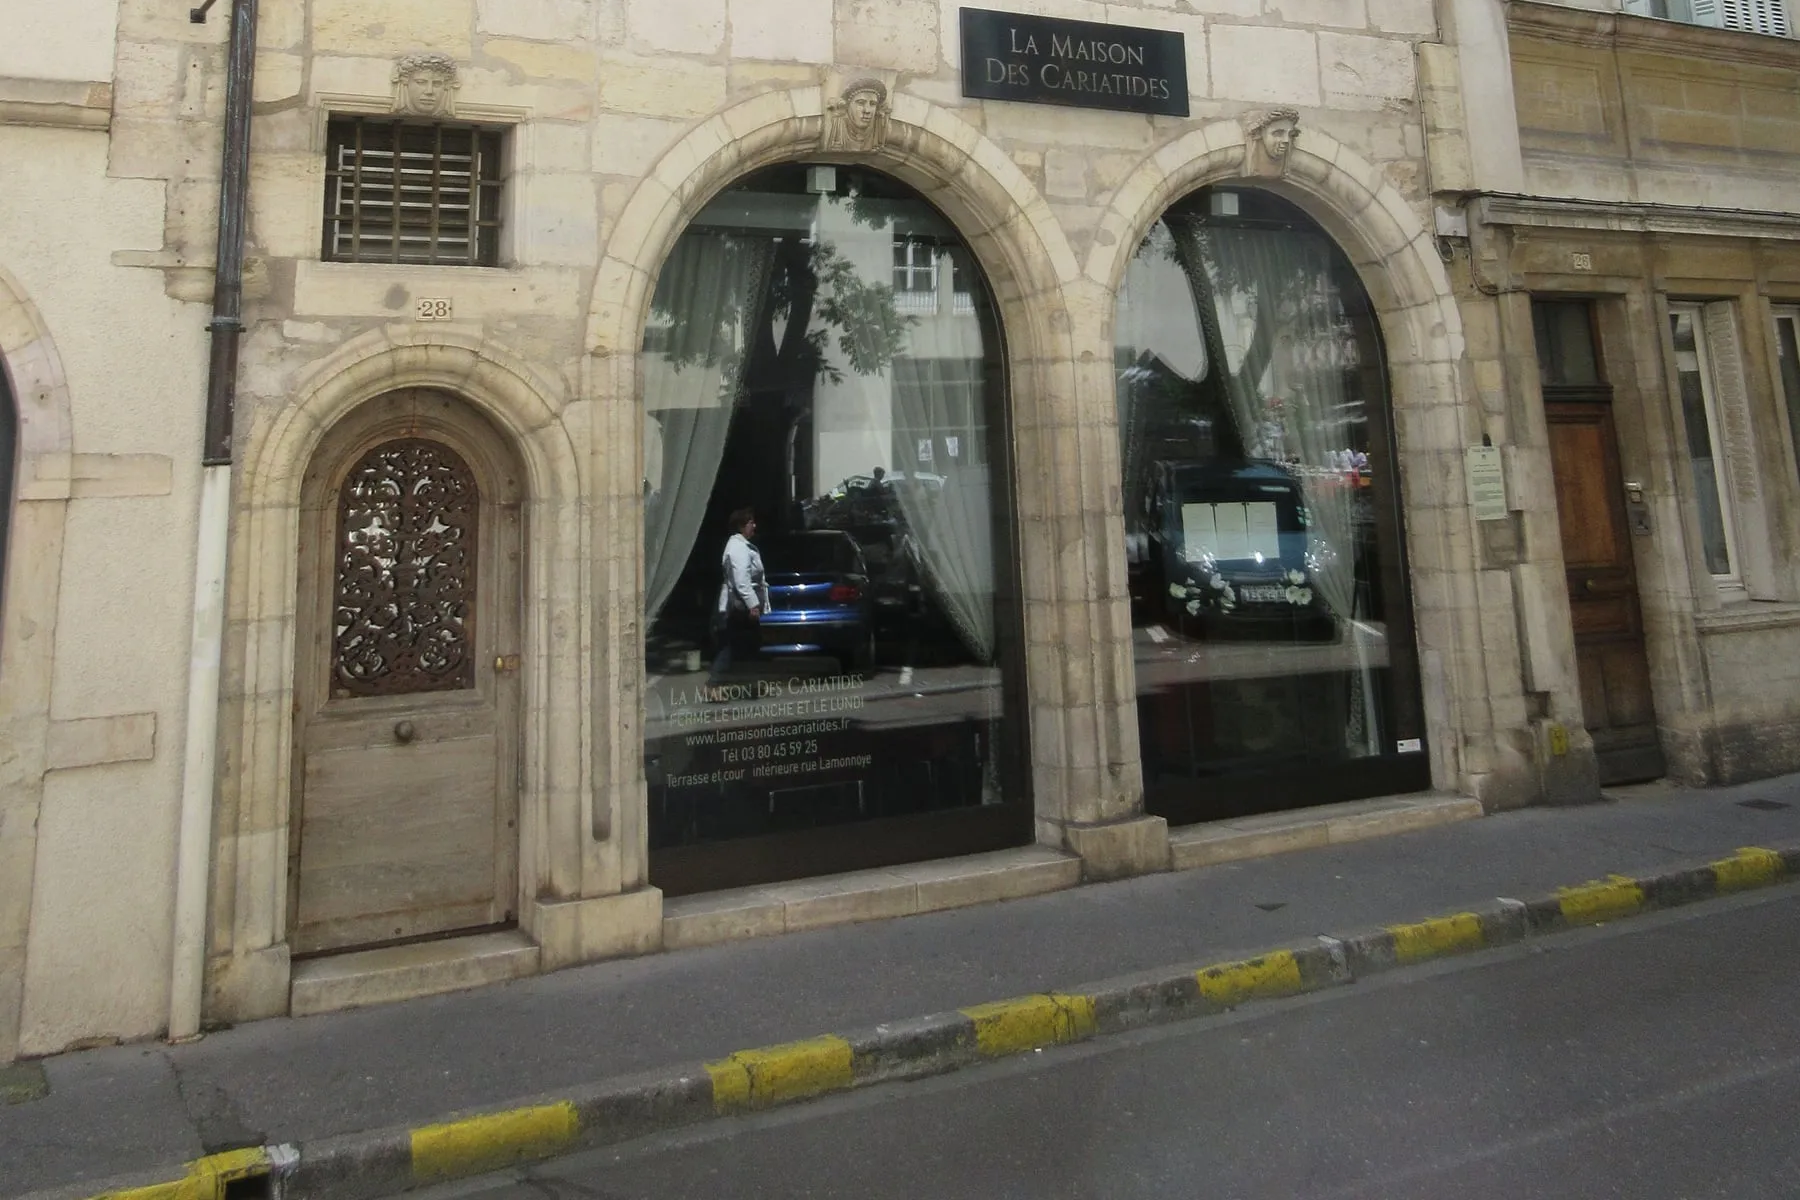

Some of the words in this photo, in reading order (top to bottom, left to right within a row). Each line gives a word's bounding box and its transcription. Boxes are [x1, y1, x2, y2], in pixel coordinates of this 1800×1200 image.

[1051, 33, 1144, 65] MAISON
[984, 57, 1030, 87] DES
[1041, 63, 1170, 99] CARIATIDES
[421, 300, 448, 317] 28
[694, 683, 752, 705] MAISON
[757, 679, 783, 698] DES
[787, 673, 865, 696] CARIATIDES
[714, 708, 730, 723] LE
[732, 702, 795, 722] DIMANCHE
[797, 699, 810, 715] ET
[813, 698, 829, 713] LE
[830, 695, 864, 712] LUNDI
[686, 718, 849, 745] www.lamaisondescariatides.fr
[721, 749, 739, 763] Tél
[741, 745, 756, 761] 03
[757, 743, 772, 759] 80
[773, 742, 788, 757] 45
[789, 740, 803, 756] 59
[804, 738, 818, 754] 25
[667, 772, 710, 789] Terrasse
[711, 769, 721, 784] et
[723, 767, 747, 781] cour
[752, 760, 800, 778] intérieure
[801, 759, 818, 774] rue
[820, 754, 872, 770] Lamonnoye
